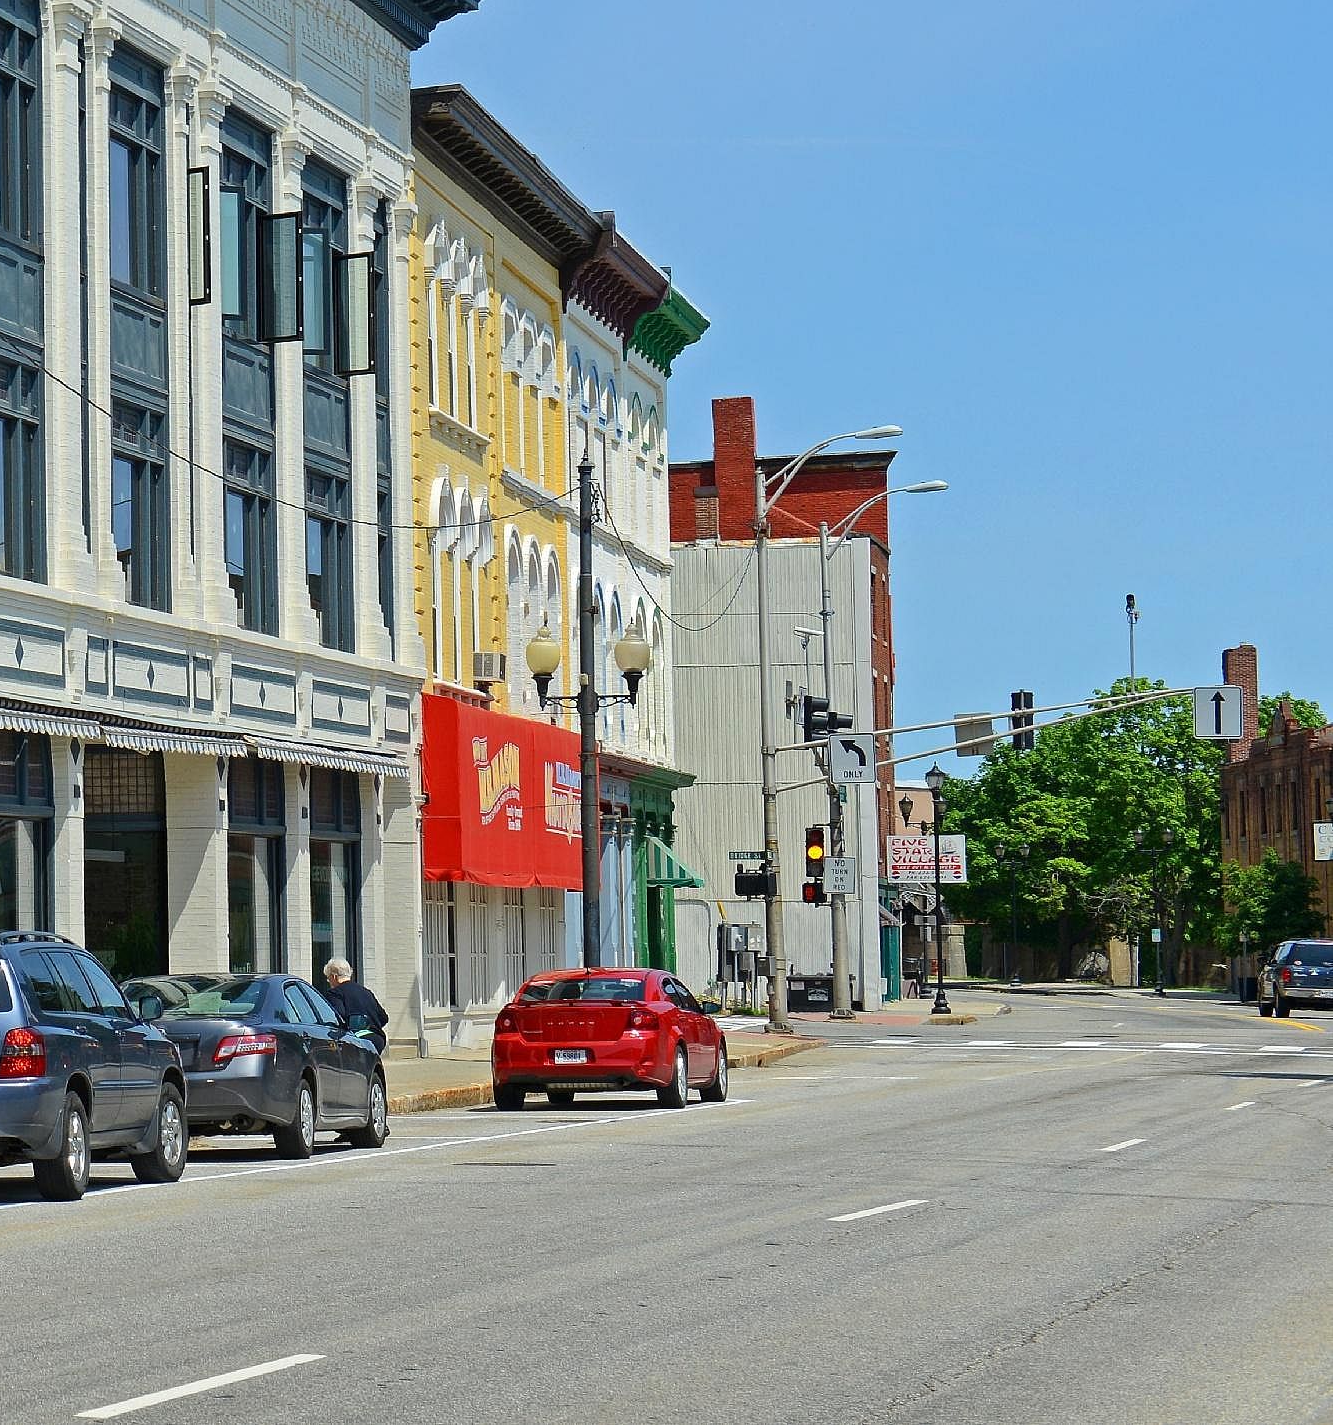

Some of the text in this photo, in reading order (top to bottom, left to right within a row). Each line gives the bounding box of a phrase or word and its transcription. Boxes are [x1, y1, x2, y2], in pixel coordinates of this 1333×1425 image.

[843, 770, 864, 779] ONLY
[892, 838, 928, 846] FIVE
[892, 847, 933, 855] STAR
[892, 855, 961, 864] VILLAGE
